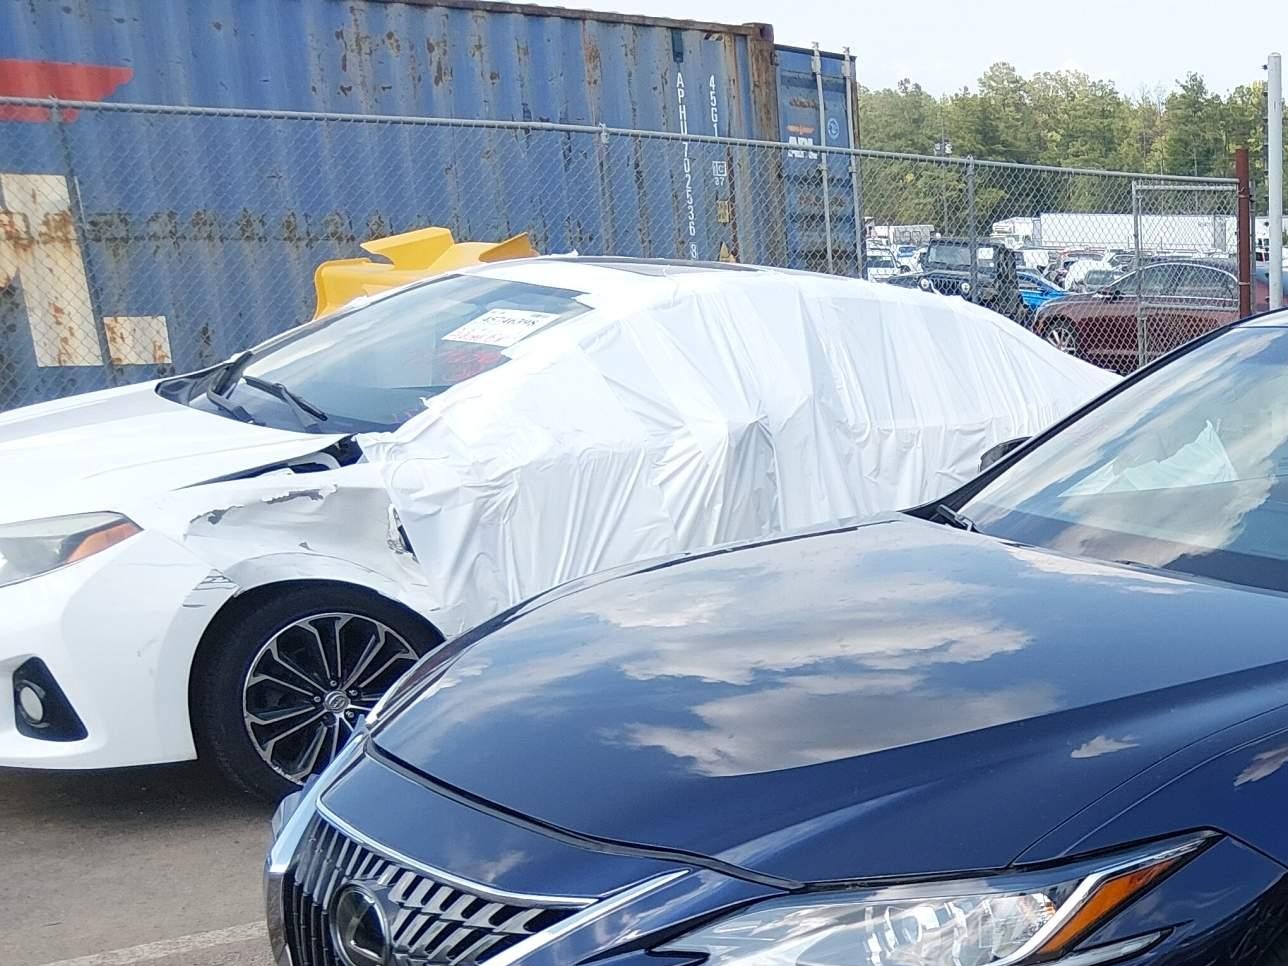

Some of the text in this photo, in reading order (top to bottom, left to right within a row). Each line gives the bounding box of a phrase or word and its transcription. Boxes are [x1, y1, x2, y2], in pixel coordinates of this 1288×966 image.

[677, 72, 688, 136] APHU
[683, 141, 696, 236] 702536
[709, 75, 718, 138] 45G1
